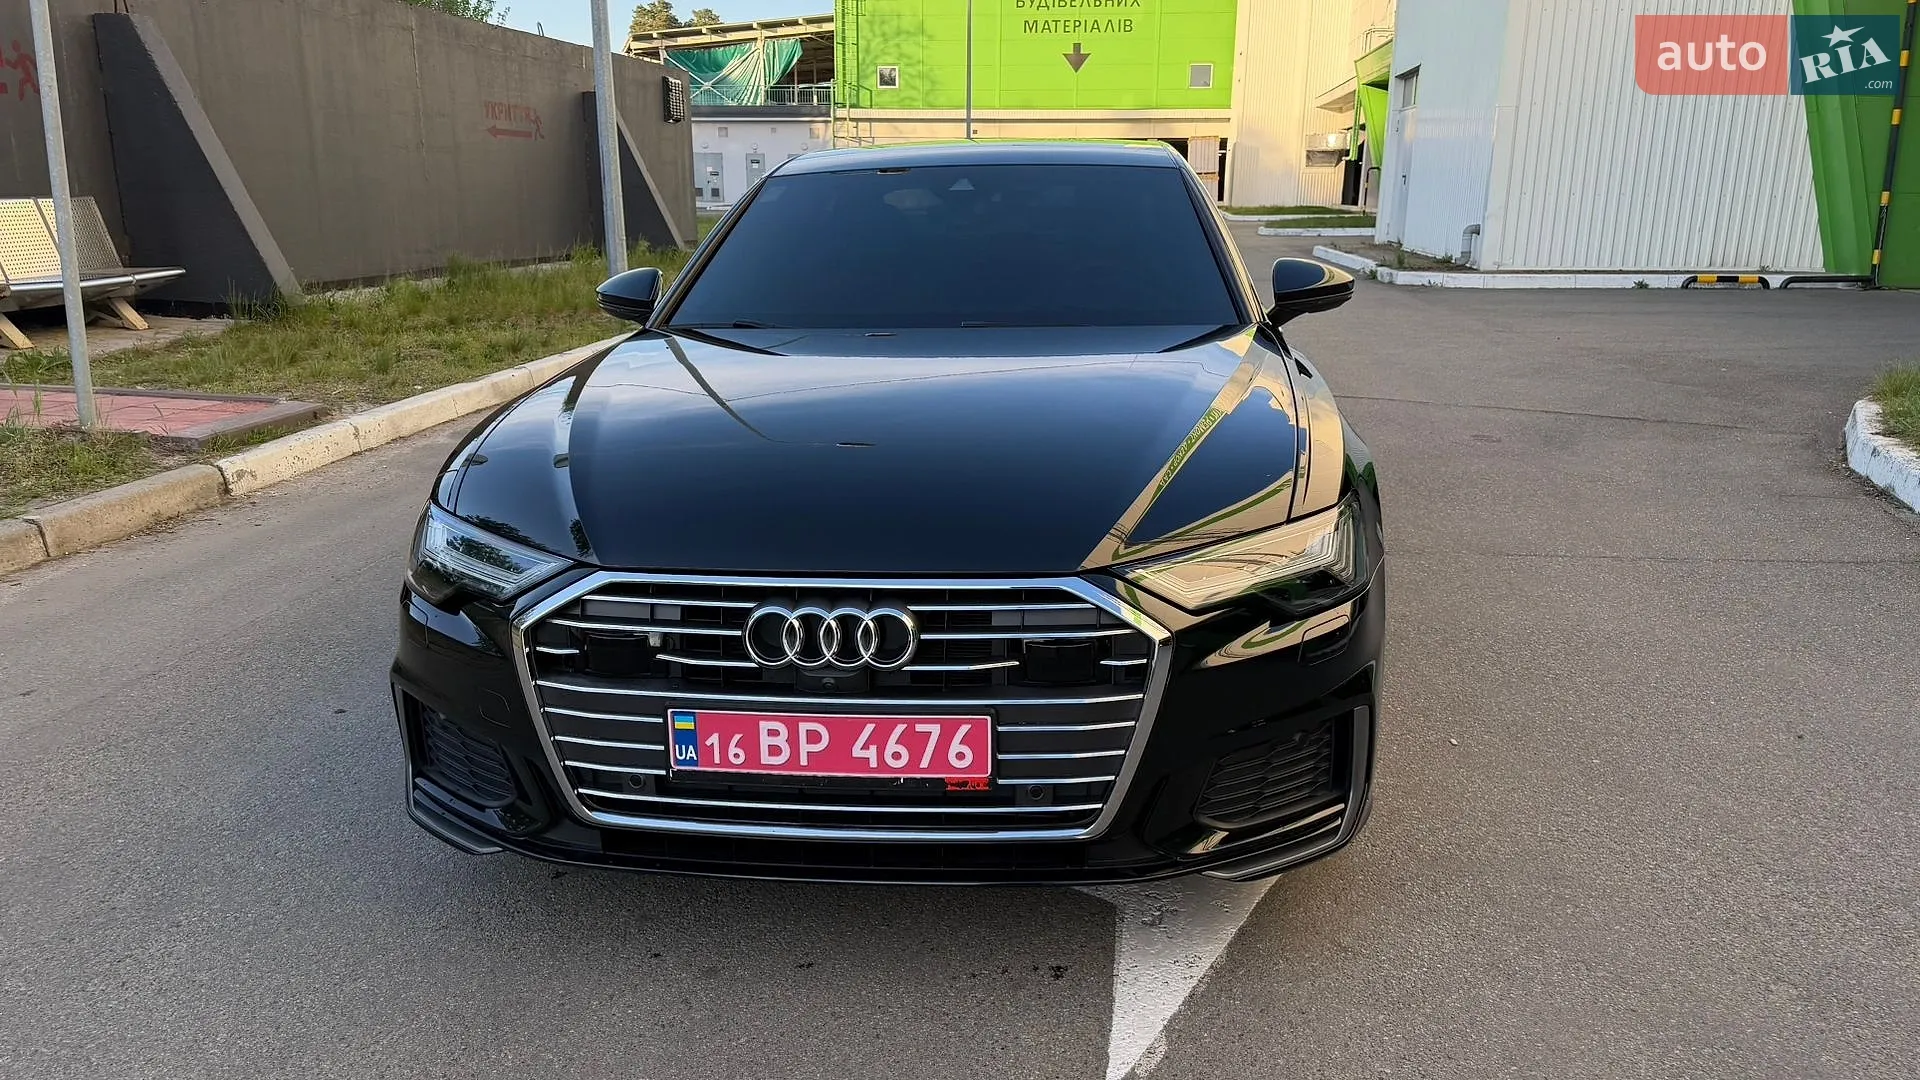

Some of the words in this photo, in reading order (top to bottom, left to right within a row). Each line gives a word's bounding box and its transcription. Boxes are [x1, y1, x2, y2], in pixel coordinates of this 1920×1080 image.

[1023, 18, 1134, 34] МАТЕРІАЛІВ
[675, 744, 698, 761] UA
[704, 732, 747, 765] 16
[758, 720, 830, 767] BP
[851, 723, 974, 769] 4676
